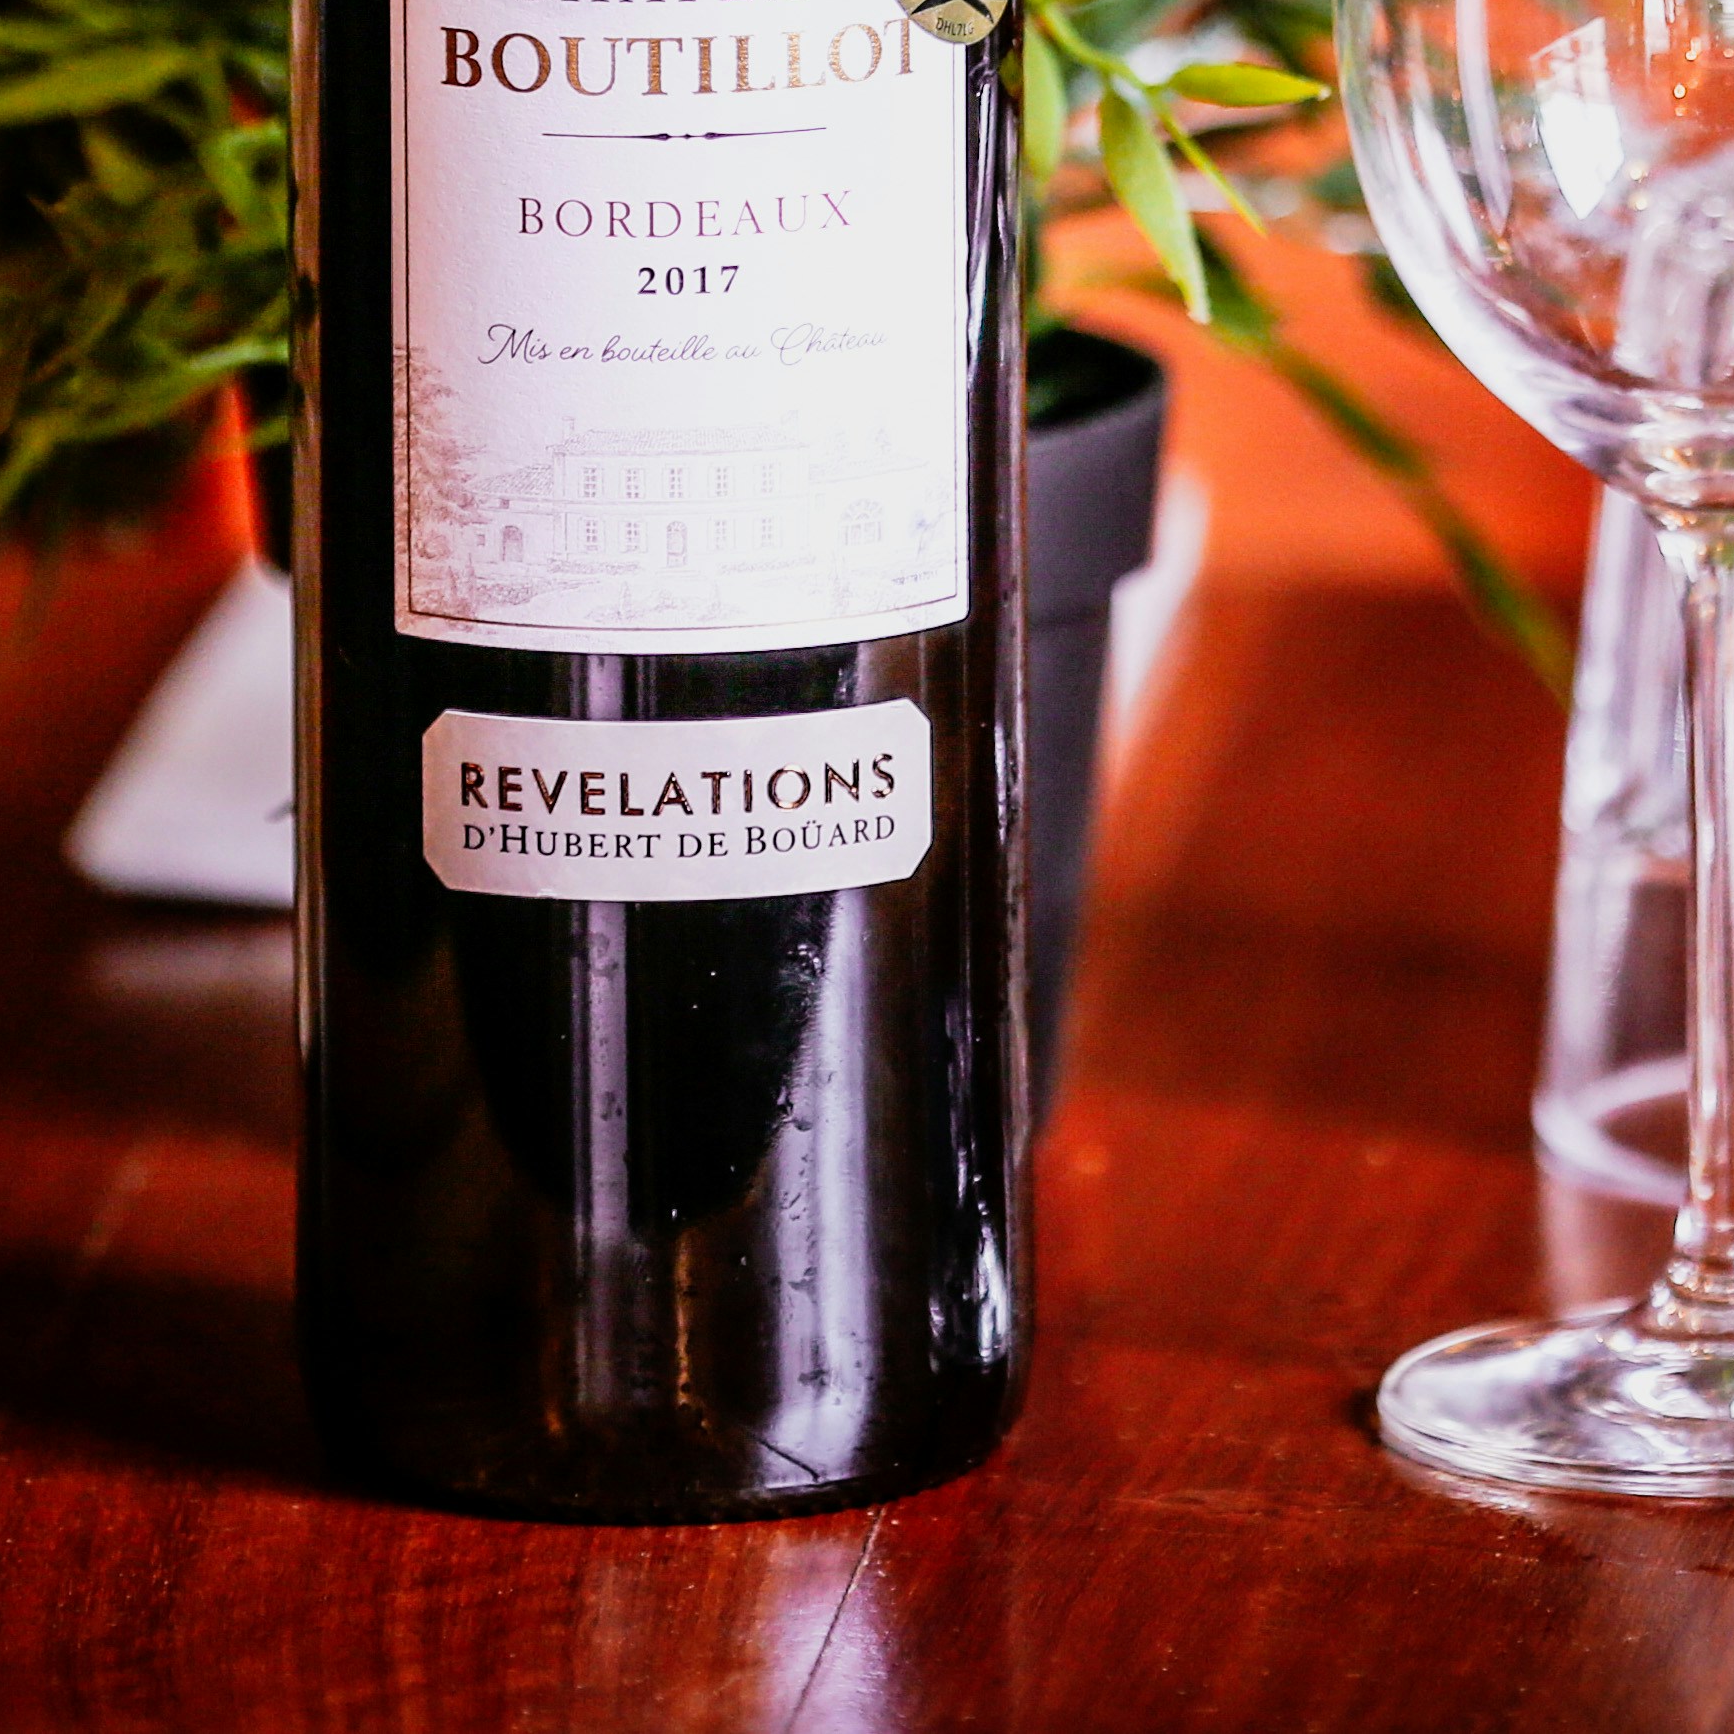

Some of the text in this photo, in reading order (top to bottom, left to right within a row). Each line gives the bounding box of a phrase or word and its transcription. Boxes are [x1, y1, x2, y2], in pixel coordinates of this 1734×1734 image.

[439, 17, 915, 96] BOUTILLOT
[517, 189, 852, 239] BORDEAUX
[636, 264, 741, 296] 2017
[477, 322, 888, 366] Mis en bouteille au Château
[460, 752, 896, 818] REVELATIONS
[677, 832, 729, 858] DE
